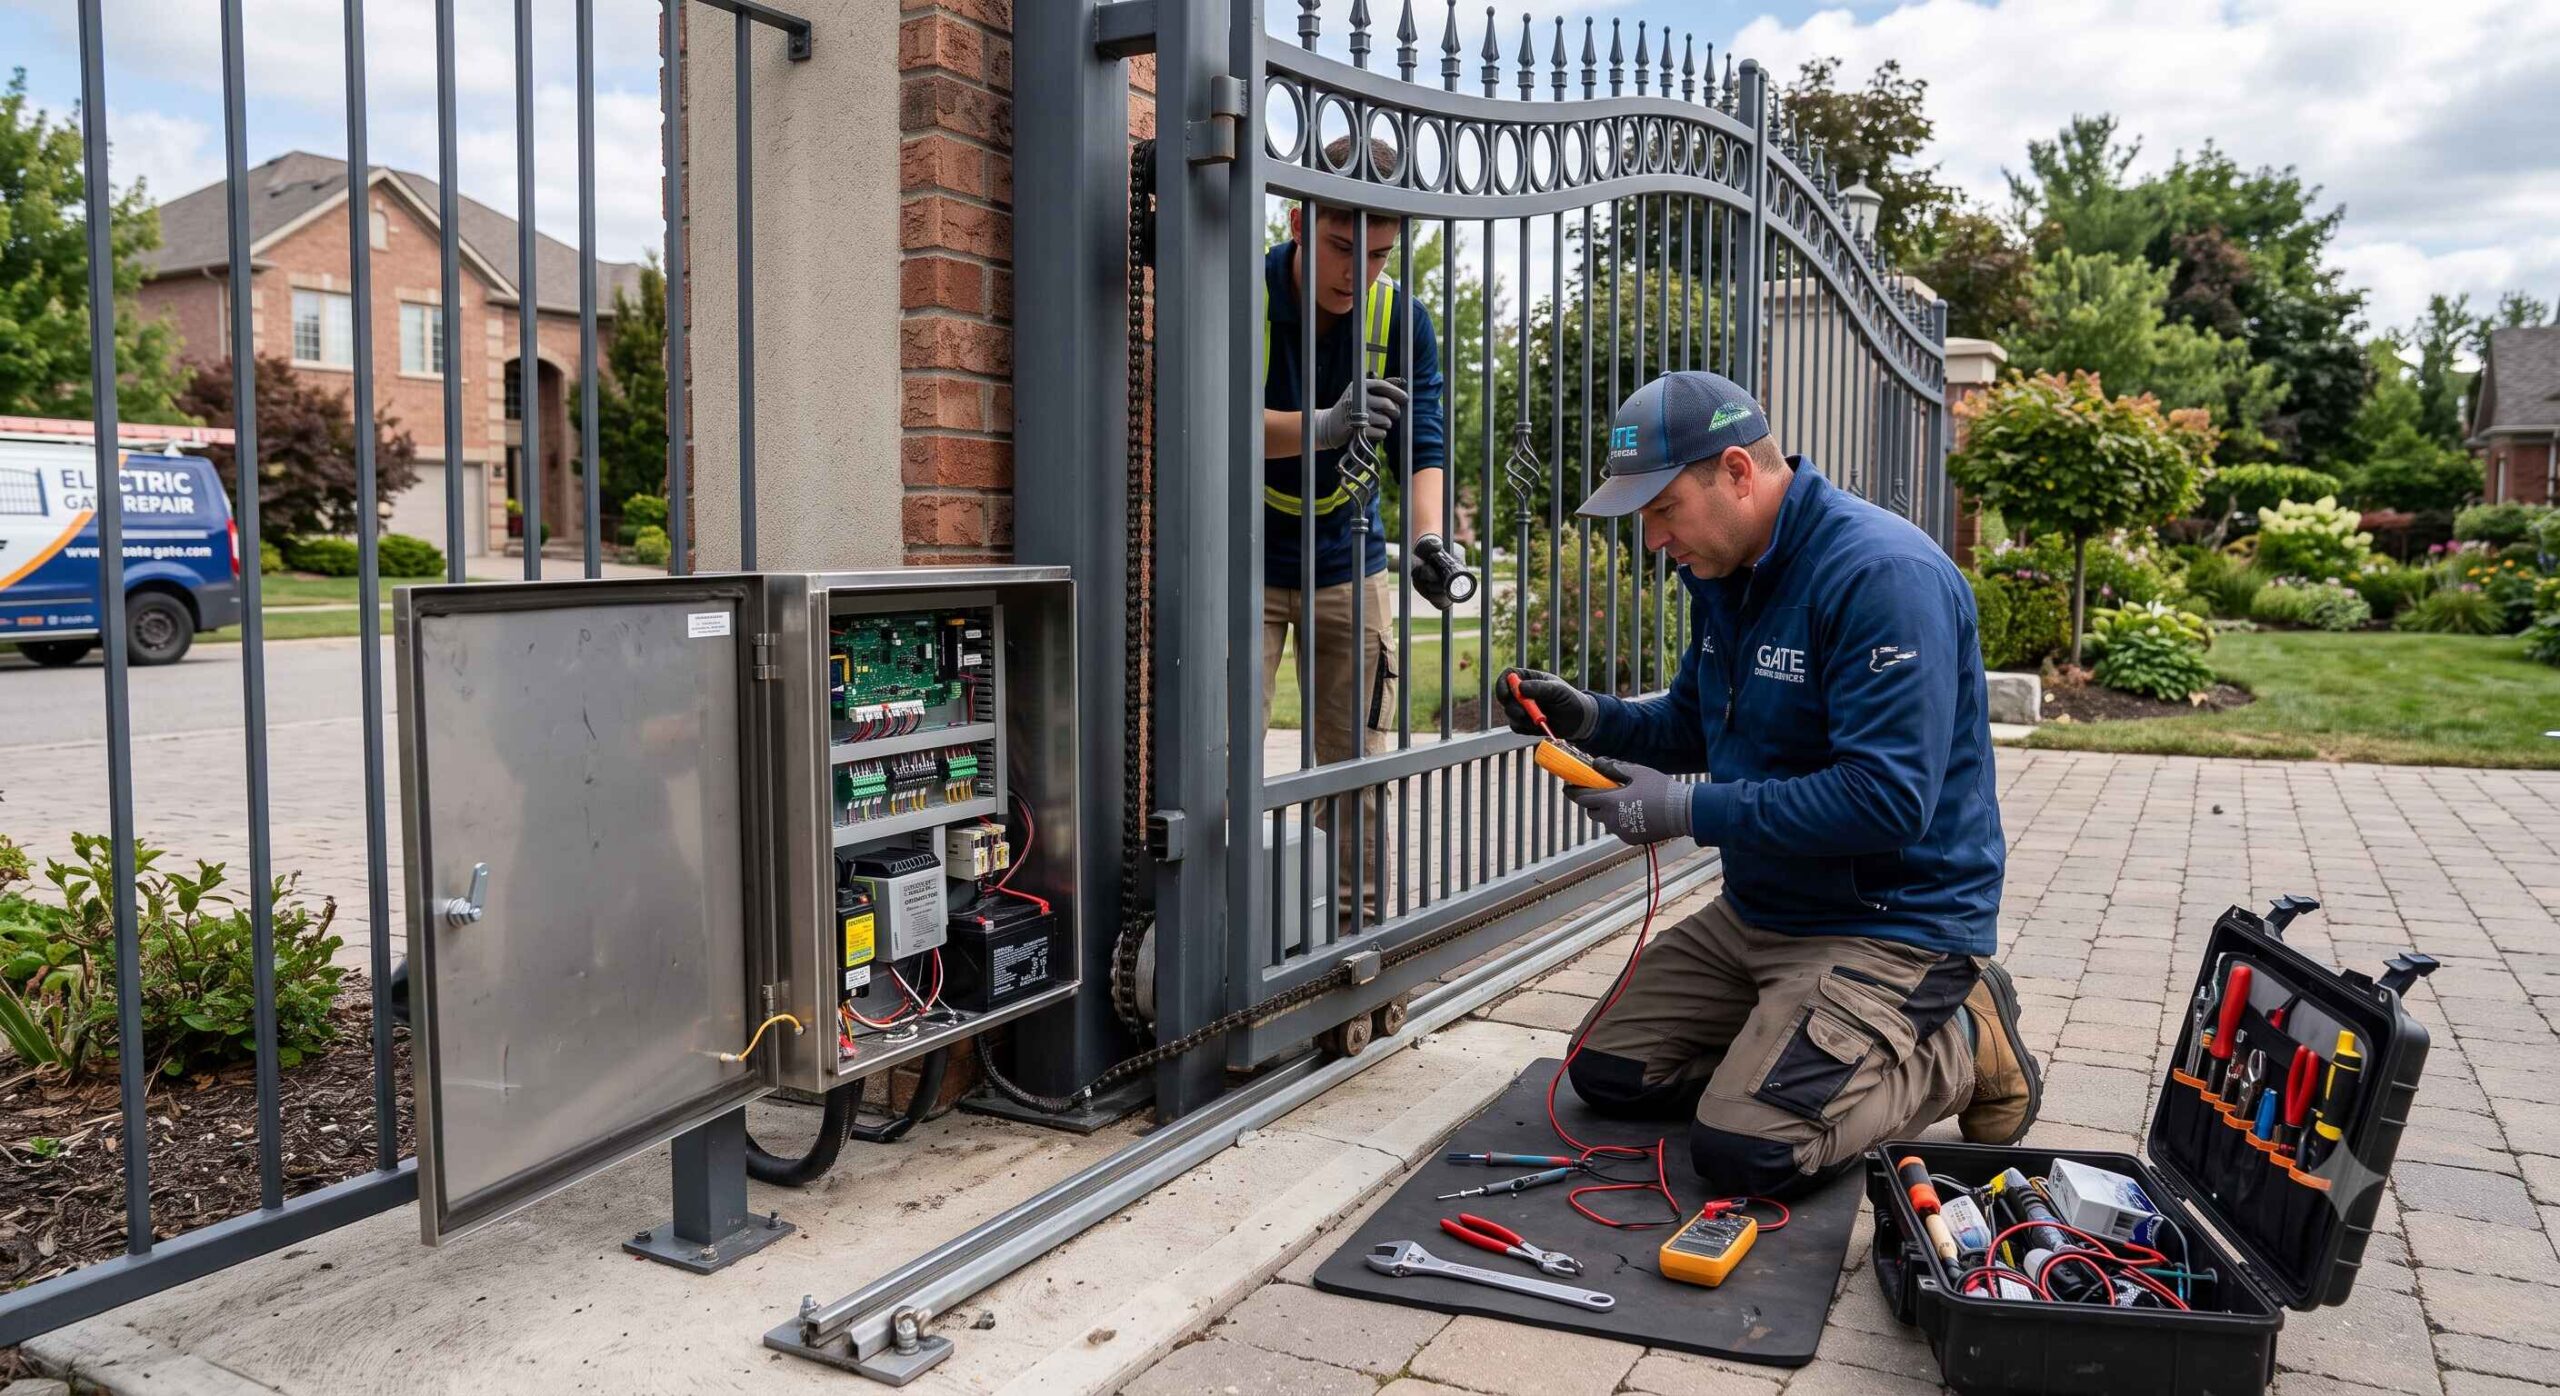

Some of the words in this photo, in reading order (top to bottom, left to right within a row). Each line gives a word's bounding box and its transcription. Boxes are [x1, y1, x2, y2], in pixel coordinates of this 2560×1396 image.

[61, 469, 193, 494] ELCTRIC
[123, 495, 194, 515] REPAIR
[1756, 645, 1806, 674] GATE
